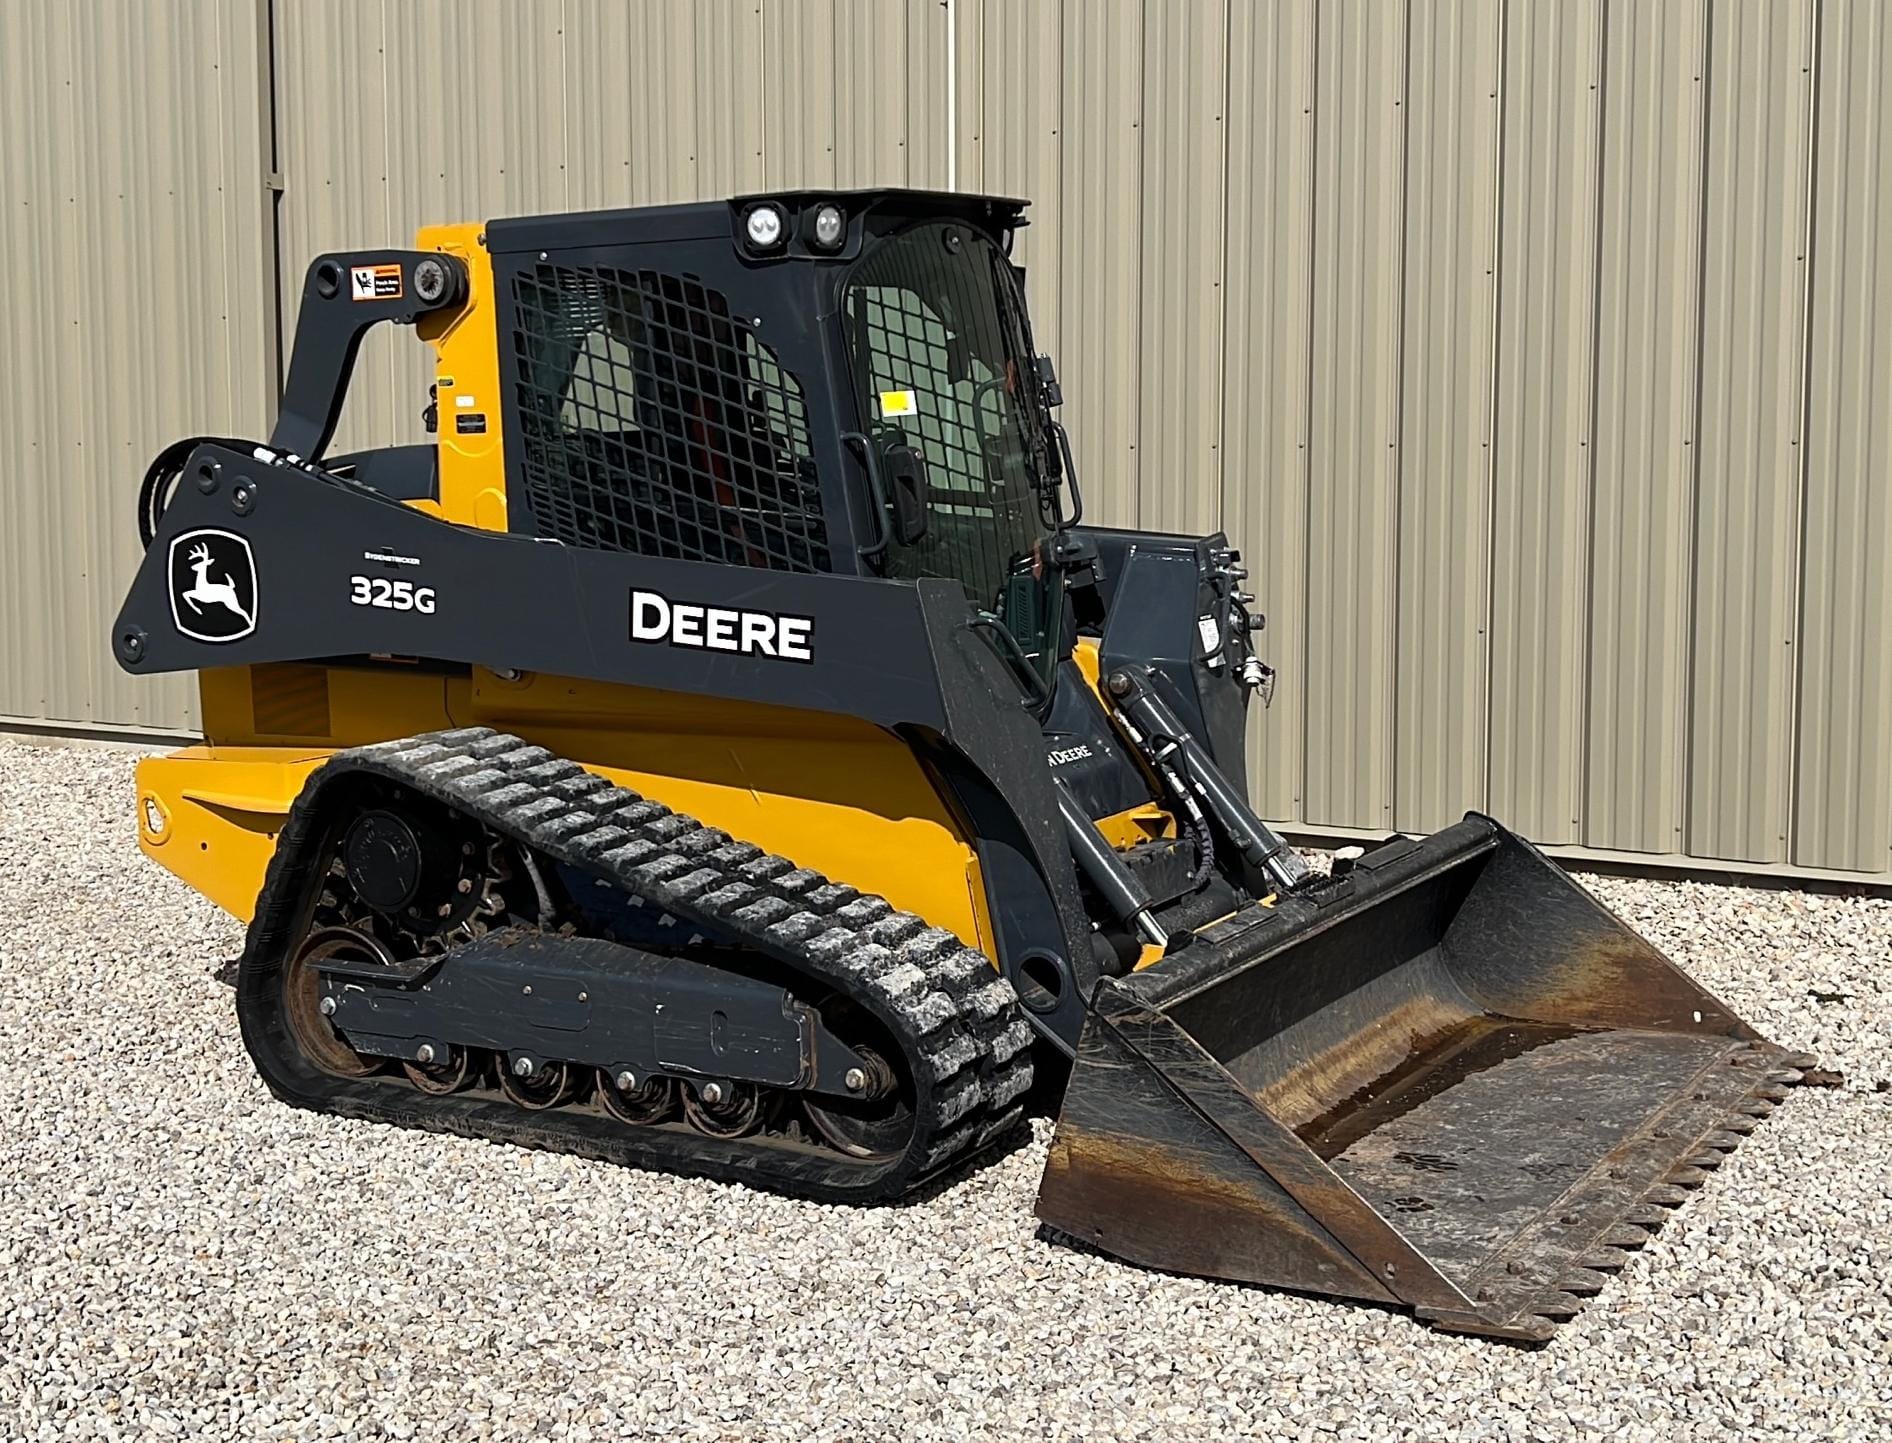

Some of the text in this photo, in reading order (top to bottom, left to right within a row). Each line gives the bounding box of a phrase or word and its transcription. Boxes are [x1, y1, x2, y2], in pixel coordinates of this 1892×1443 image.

[351, 575, 435, 613] 325G
[632, 591, 812, 660] DEERE
[1050, 745, 1093, 764] DEERE
